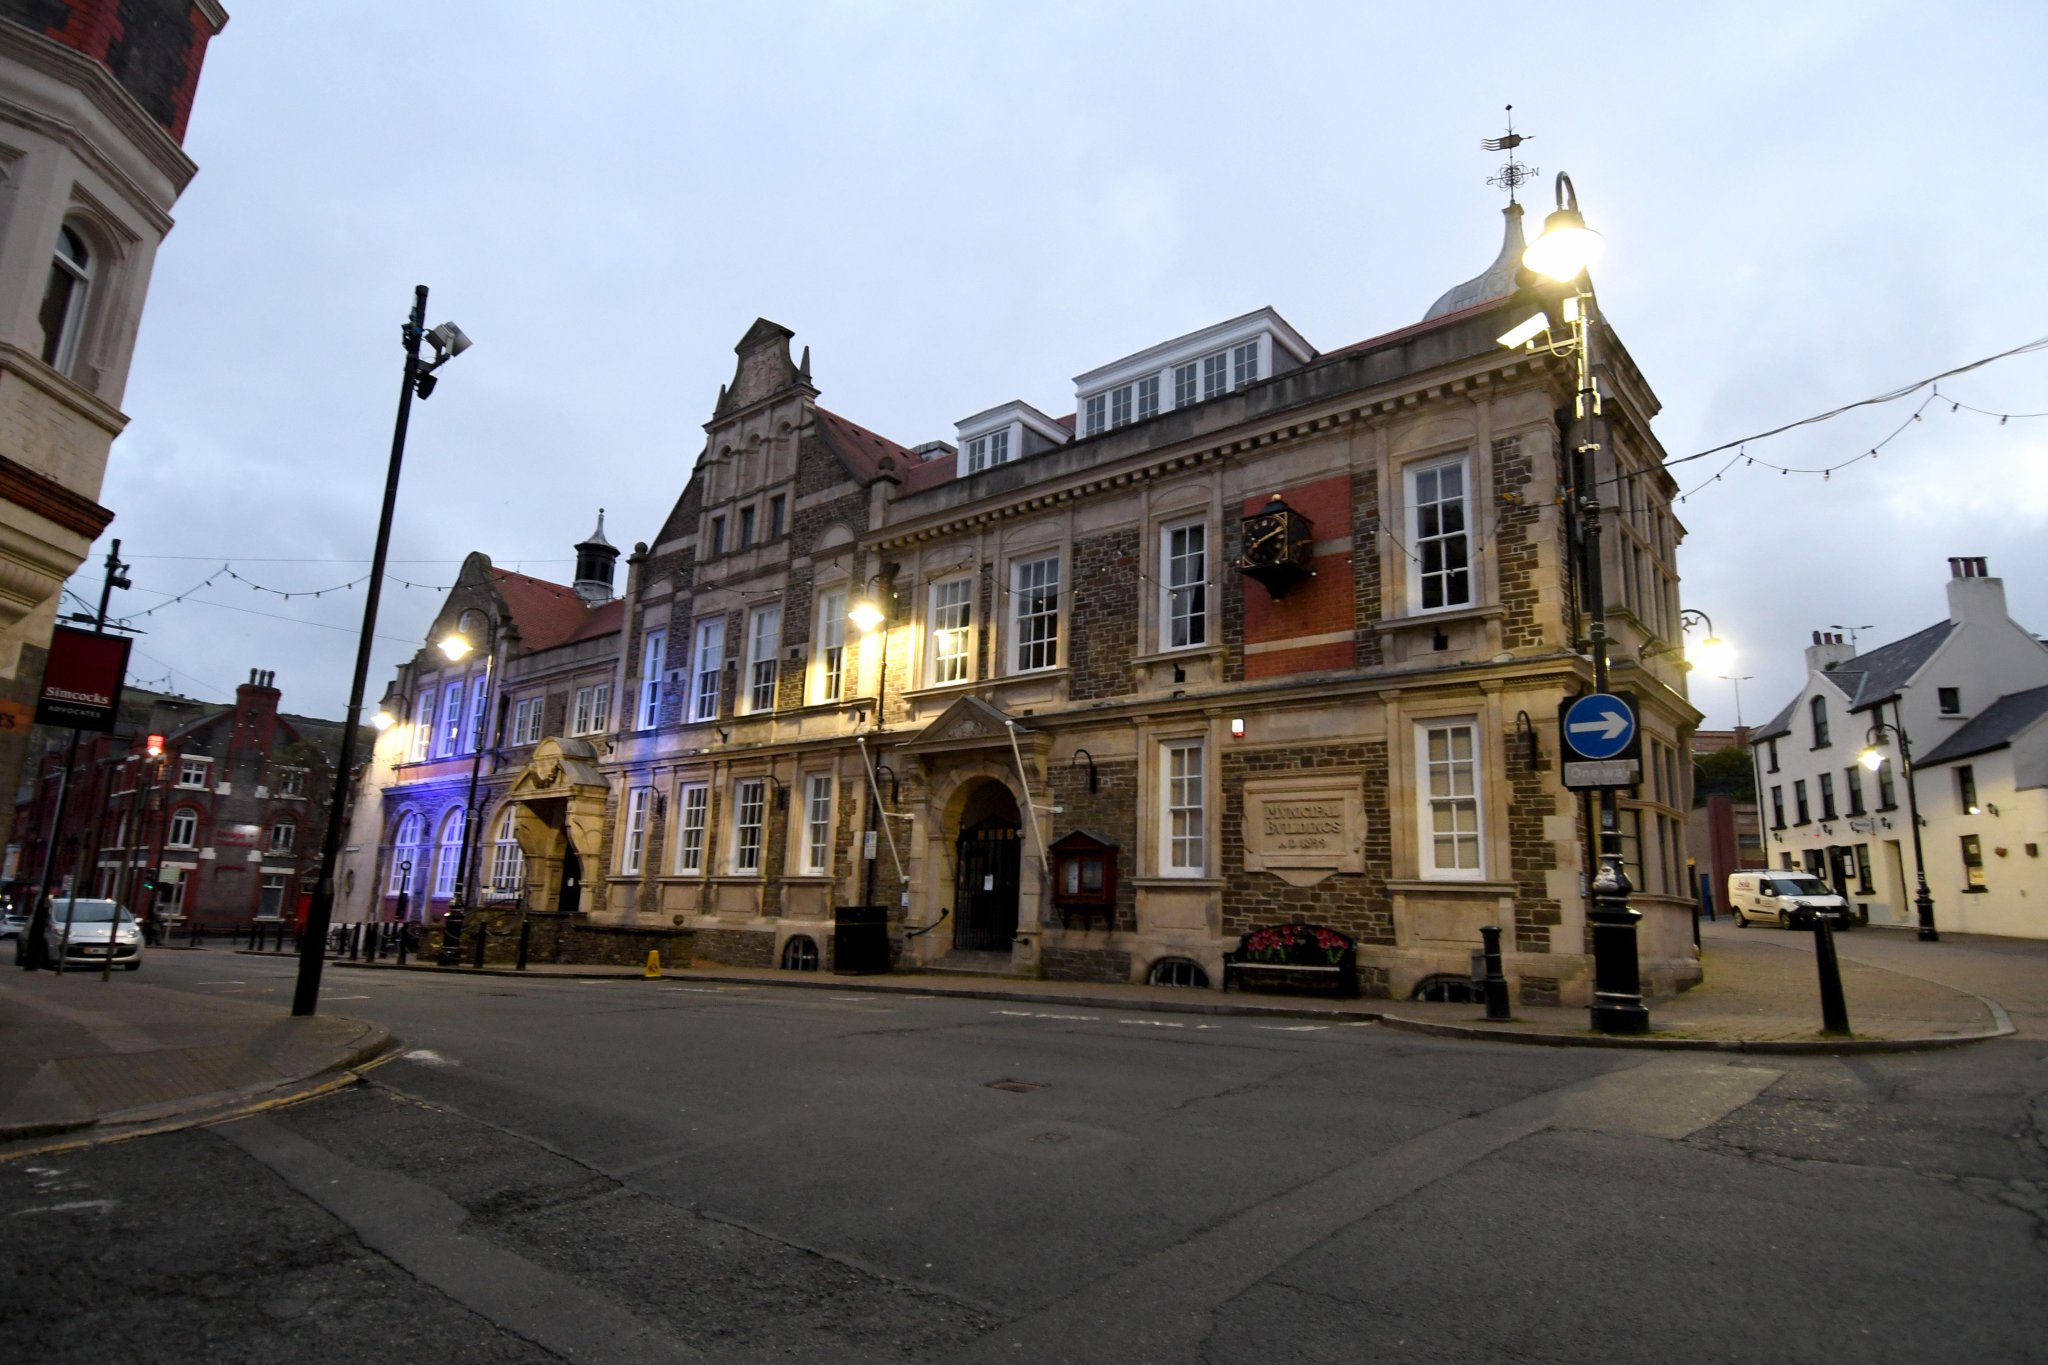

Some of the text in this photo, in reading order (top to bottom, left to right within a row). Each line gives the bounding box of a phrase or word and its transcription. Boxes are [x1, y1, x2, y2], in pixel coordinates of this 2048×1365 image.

[46, 686, 109, 704] Simcocks
[48, 705, 101, 718] ADVOCATES
[1570, 767, 1599, 779] One
